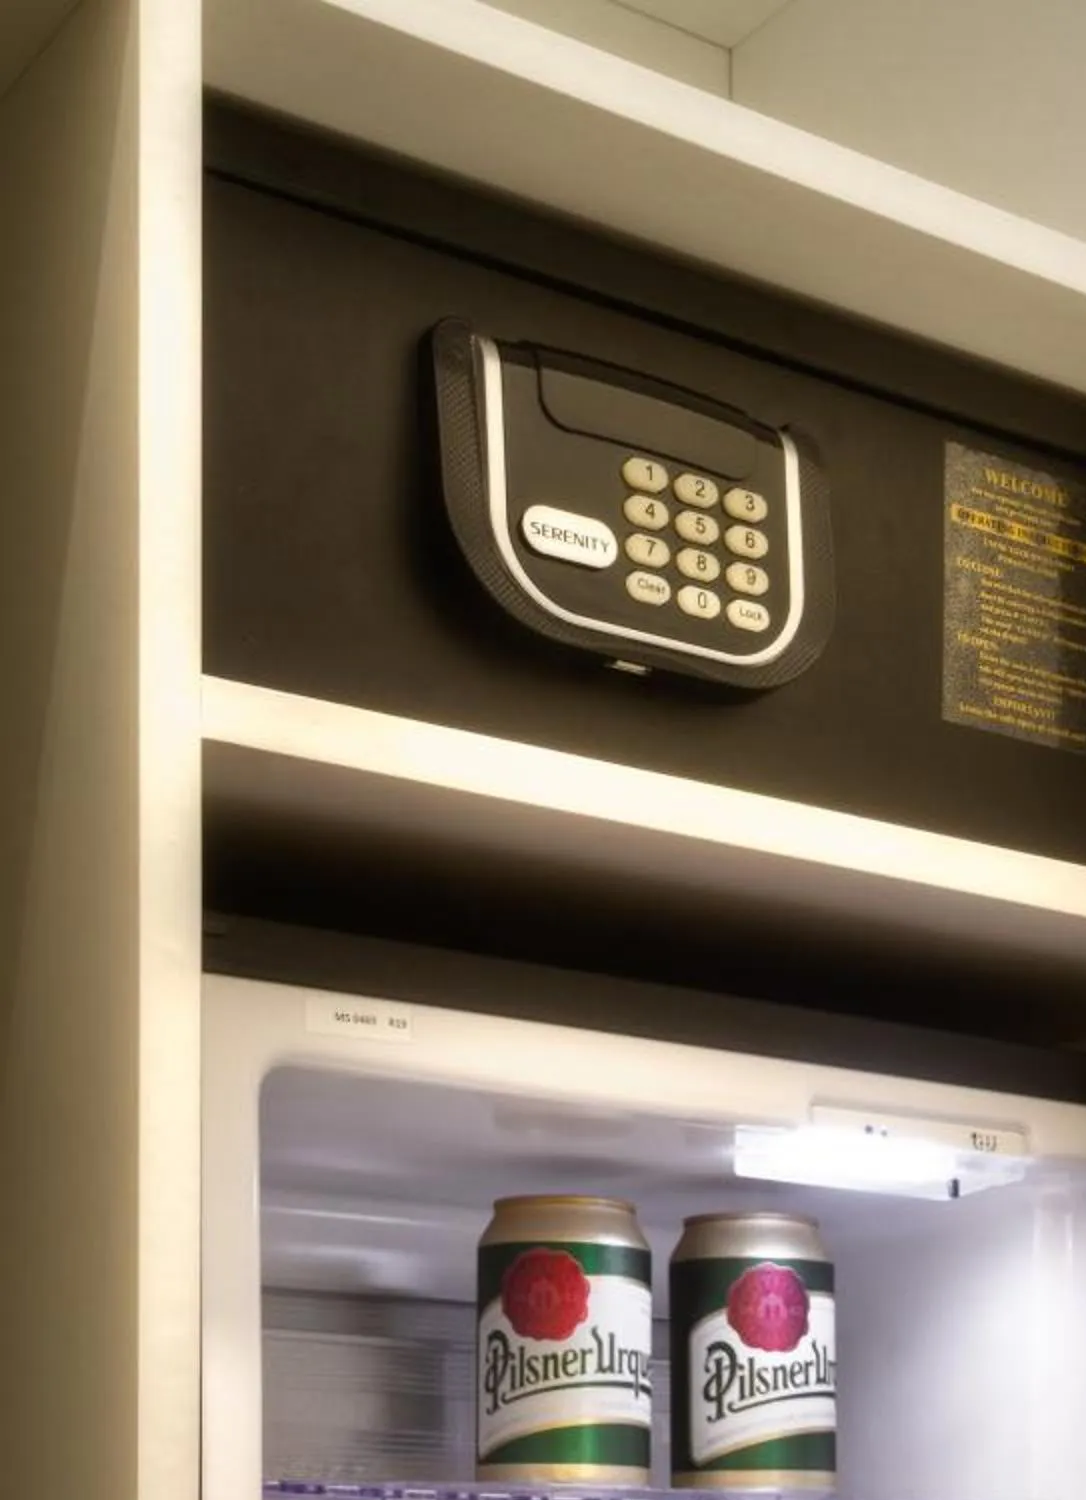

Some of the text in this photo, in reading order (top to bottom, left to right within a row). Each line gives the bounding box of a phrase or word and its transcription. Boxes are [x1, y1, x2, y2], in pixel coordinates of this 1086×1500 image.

[645, 464, 755, 511] 1 2 3
[983, 467, 1069, 508] WELCOME
[530, 521, 611, 553] SERENITY
[645, 503, 755, 549] 4 5 6
[646, 539, 756, 585] 7 8 9
[697, 592, 706, 609] 0
[485, 1330, 593, 1415] Pilsner
[703, 1341, 813, 1423] Pilsner
